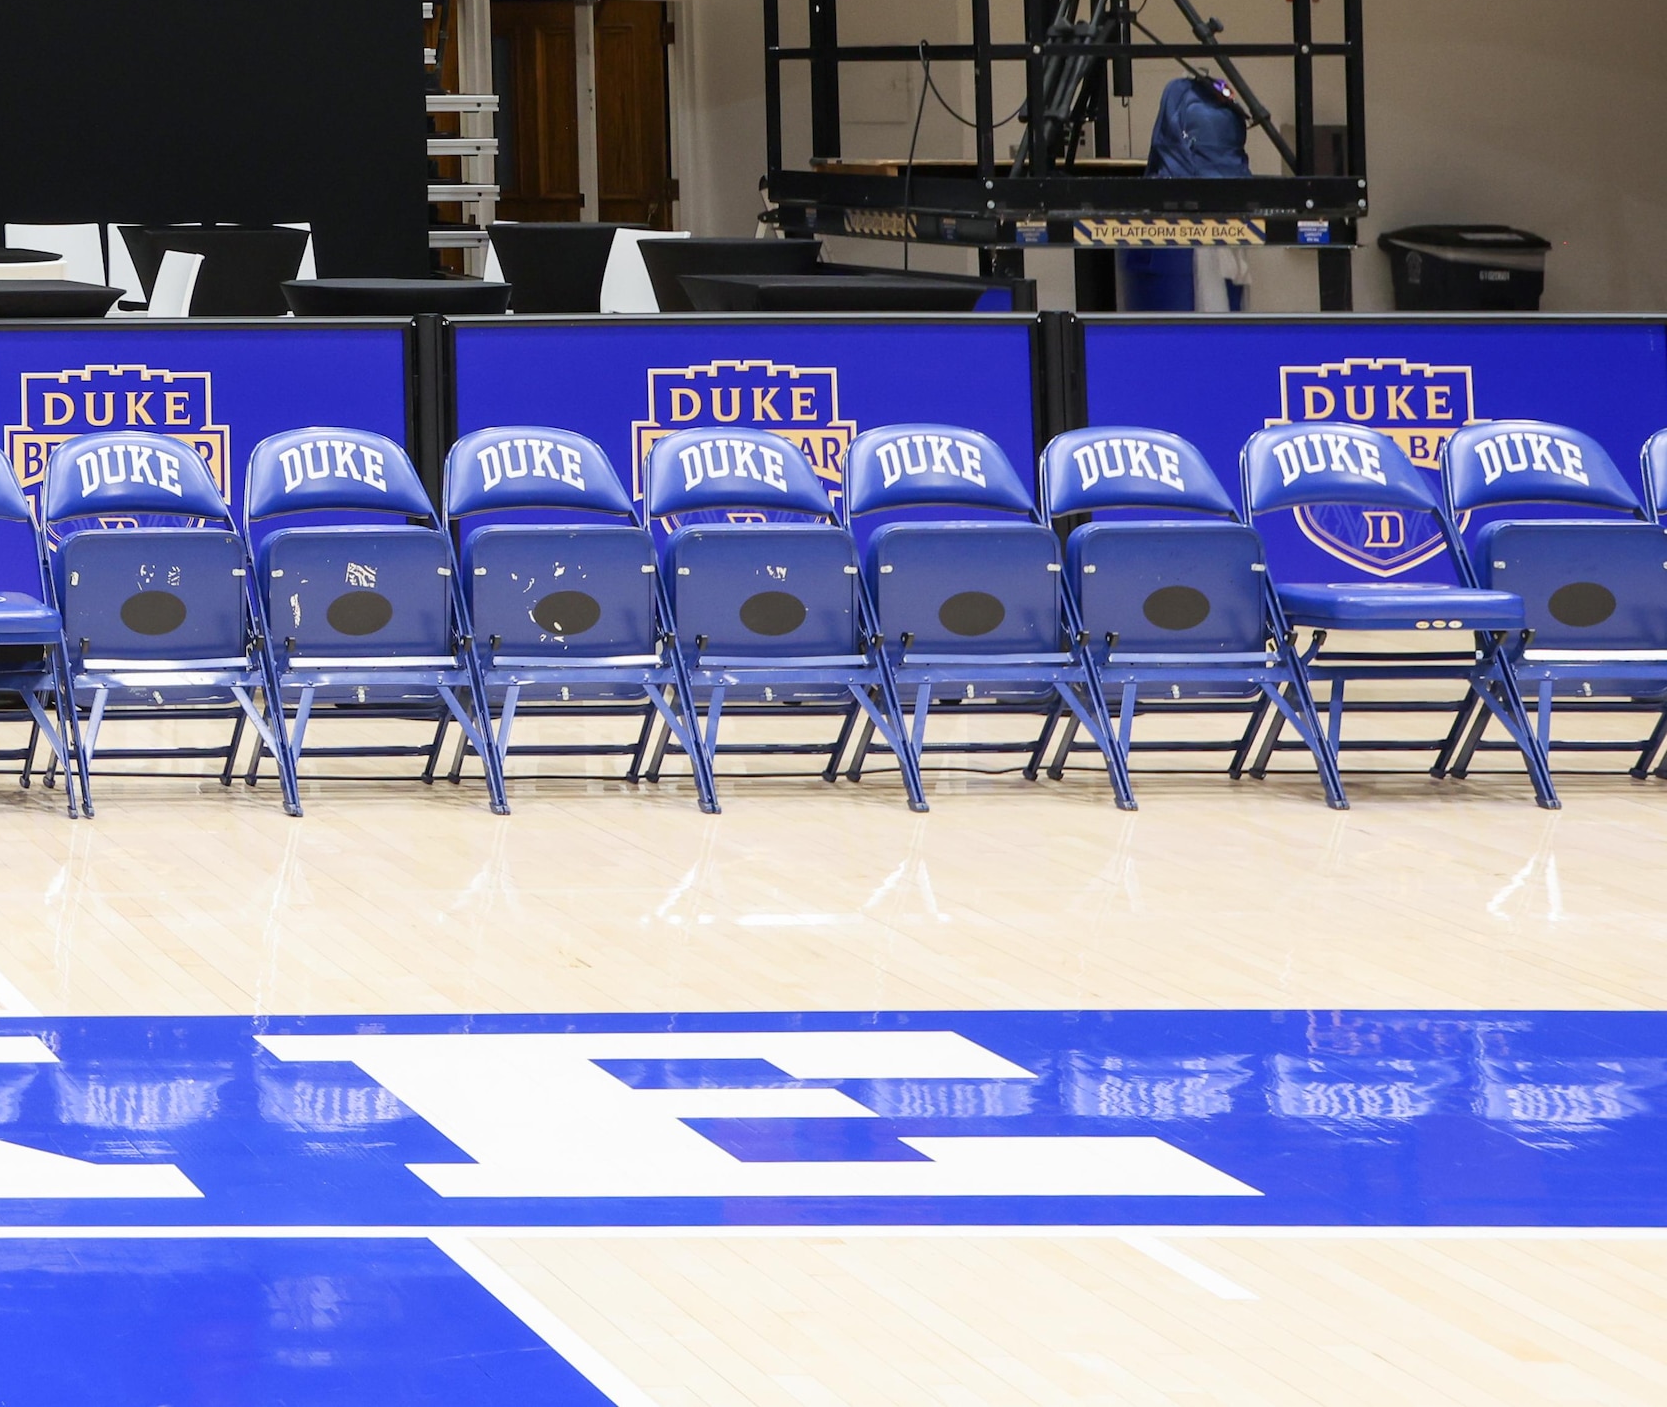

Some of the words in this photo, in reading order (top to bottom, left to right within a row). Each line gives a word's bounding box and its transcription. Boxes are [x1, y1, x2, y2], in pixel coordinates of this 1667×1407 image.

[1094, 227, 1108, 237] TV
[1112, 227, 1175, 237] PLATFORM
[1180, 227, 1207, 237] STAY
[1212, 227, 1245, 237] BACK
[43, 392, 191, 425] DUKE
[670, 388, 818, 421] DUKE
[1302, 385, 1453, 420] DUKE
[75, 444, 182, 498] DUKE
[278, 439, 387, 494] DUKE
[476, 438, 585, 492] DUKE
[678, 439, 788, 493] DUKE
[875, 434, 986, 489] DUKE
[1072, 438, 1185, 492] DUKE
[1272, 432, 1387, 487] DUKE
[1474, 432, 1590, 486] DUKE
